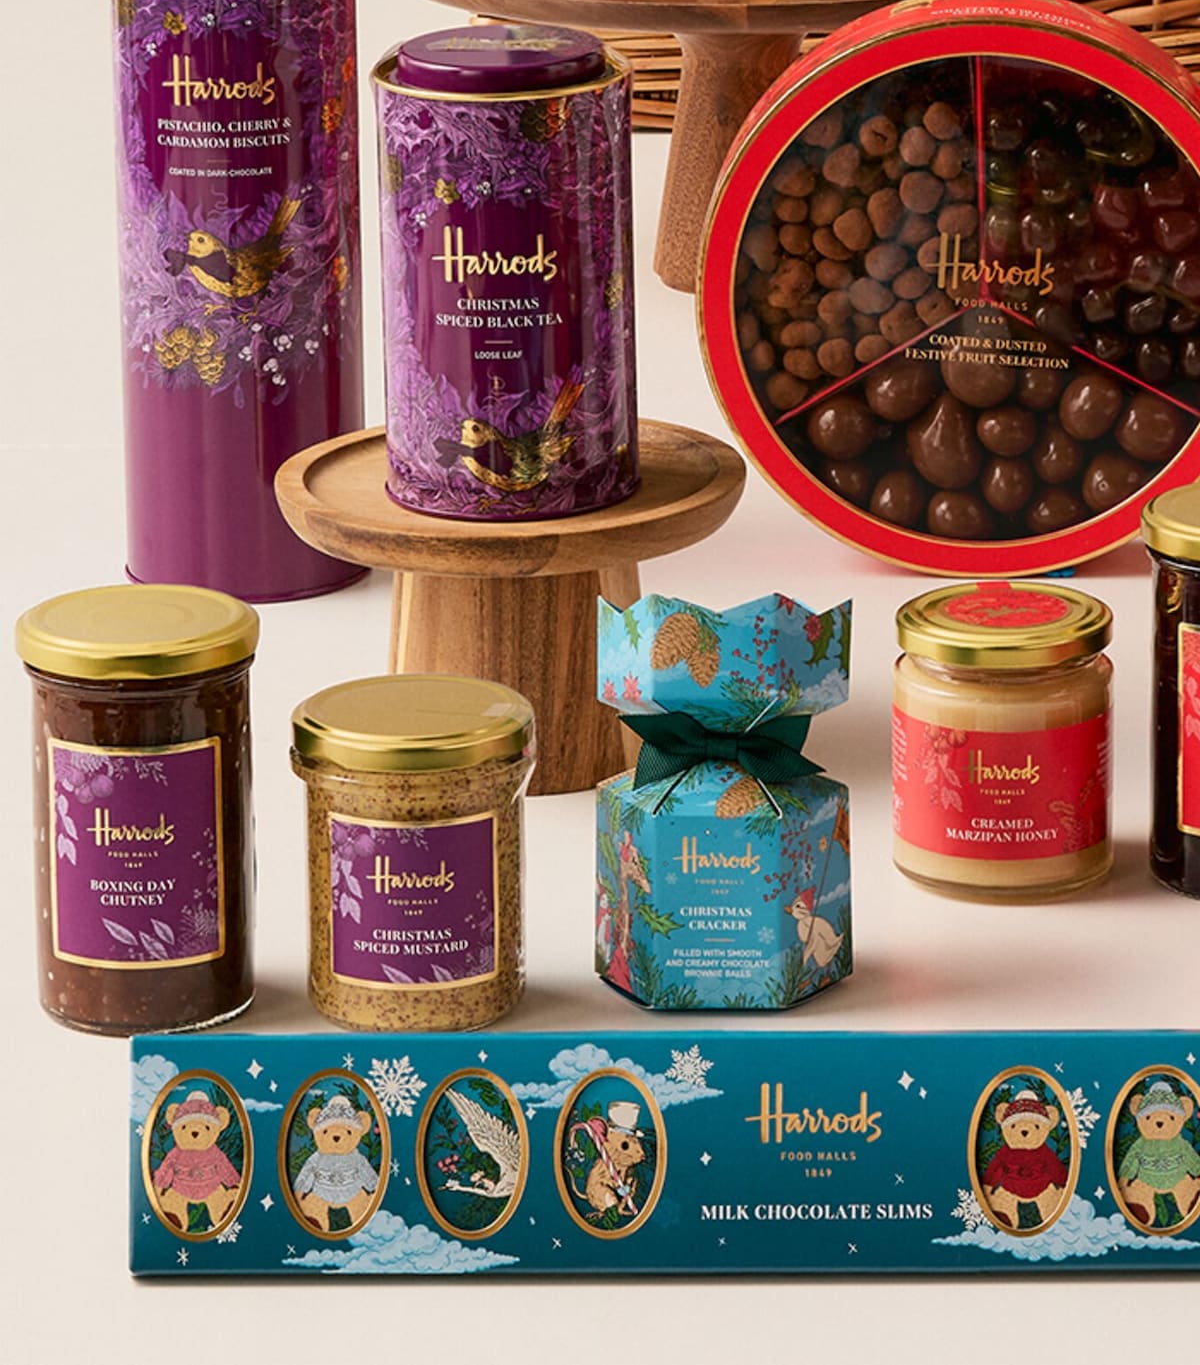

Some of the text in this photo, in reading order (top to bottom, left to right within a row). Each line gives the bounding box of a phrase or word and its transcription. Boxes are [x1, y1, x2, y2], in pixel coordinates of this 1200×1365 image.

[162, 54, 276, 107] Harrods
[157, 117, 292, 133] PISTACHIO, CHERRY &
[157, 133, 291, 148] CARDAMOM BISCUITS
[168, 167, 205, 177] COATED IN
[432, 225, 558, 283] Harrods
[924, 232, 1055, 296] Harrods
[456, 297, 540, 311] CHRISTMAS
[954, 297, 1029, 312] FOOD HALLS
[436, 312, 563, 328] SPICED BLACK TEA
[976, 315, 1005, 325] 1849
[929, 334, 1047, 353] COATED & DUSTED
[474, 350, 523, 359] LOOSE LEAF
[904, 347, 1070, 369] FESTIVE FRUIT SELECTION
[961, 748, 1041, 785] Harrods
[86, 807, 175, 847] Harrods
[970, 817, 1034, 829] CREAMED
[946, 827, 1059, 842] MARZIPAN HONEY
[672, 836, 760, 875] Harrods
[366, 855, 455, 895] Harrods
[89, 878, 176, 893] BOXING DAY
[100, 894, 166, 907] CHUTNEY
[680, 906, 752, 917] CHRISTMAS
[689, 920, 747, 931] CRACKER
[372, 928, 453, 941] CHRISTMAS
[353, 939, 469, 955] SPICED MUSTARD
[673, 949, 762, 957] FILLED WITH SMOOTH
[665, 959, 770, 968] AND CREAMY CHOCOLATE
[684, 969, 752, 978] BROWNIE BALLS
[744, 1082, 882, 1144] Harrods
[780, 1151, 857, 1161] FOOD HALLS
[805, 1168, 832, 1178] 1849
[701, 1203, 934, 1221] MILK CHOCOLATE SLIMS
